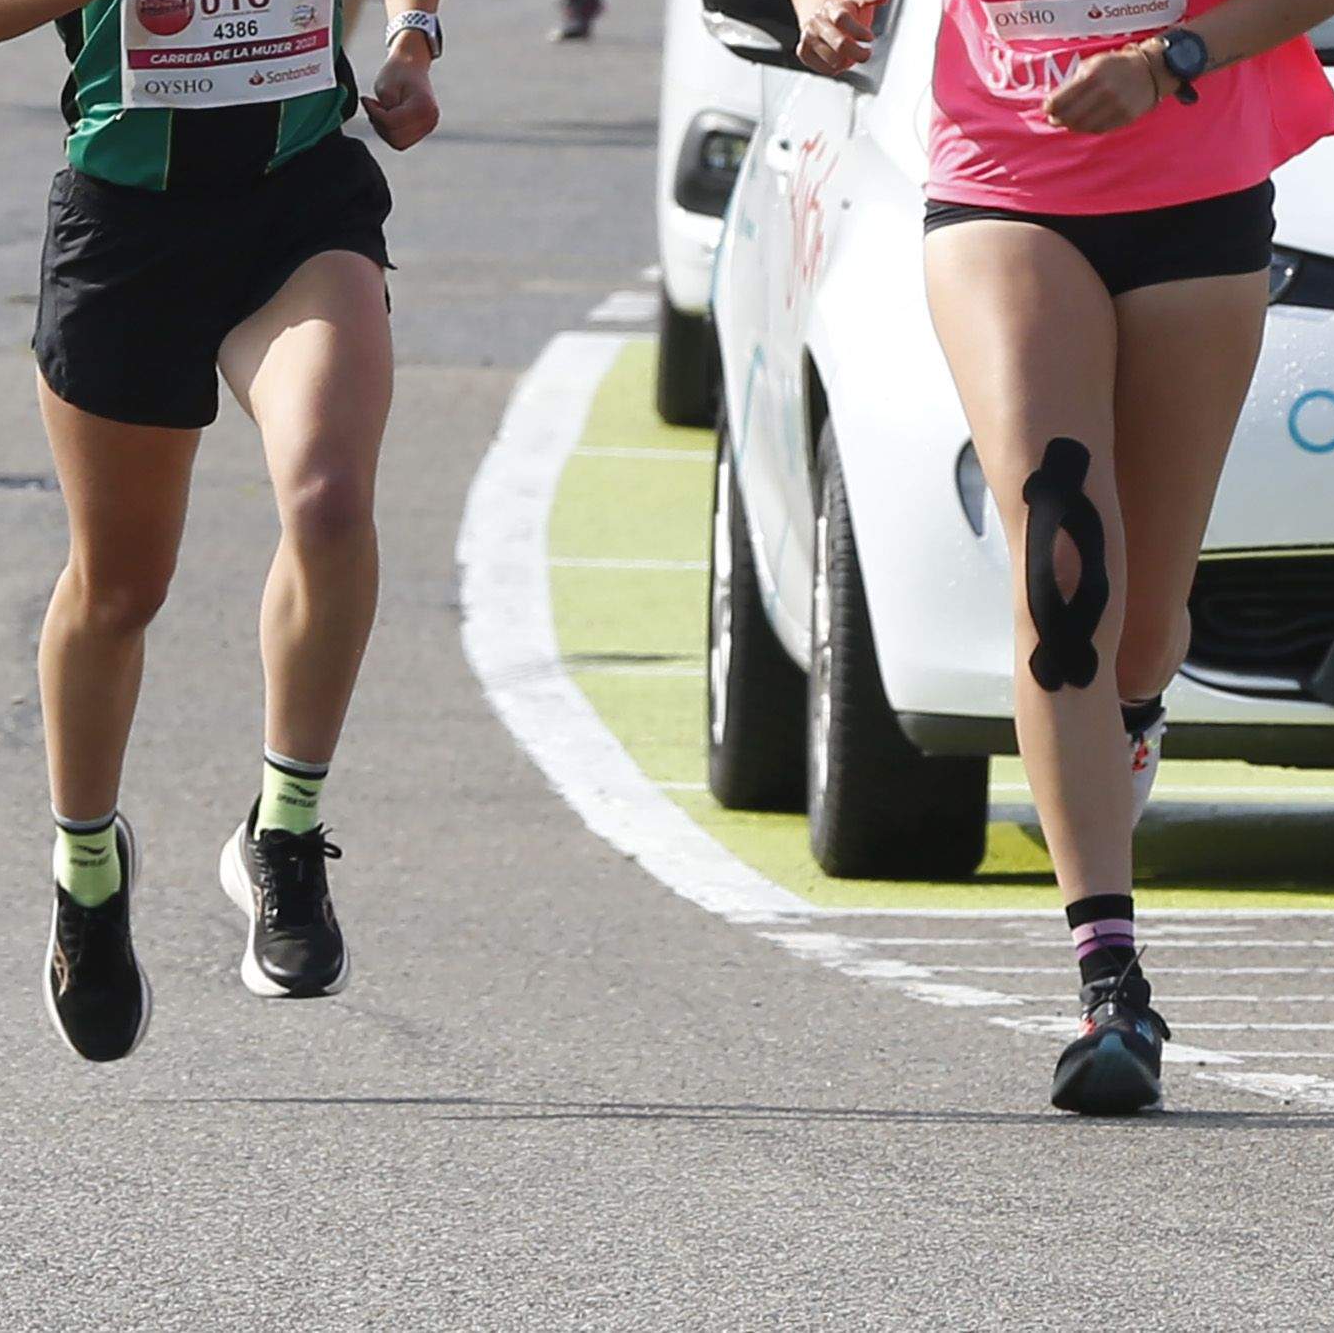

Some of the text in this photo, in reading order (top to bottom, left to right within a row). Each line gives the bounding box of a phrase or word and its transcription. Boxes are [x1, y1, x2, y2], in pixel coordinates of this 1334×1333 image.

[995, 9, 1055, 27] OYSHO
[1104, 0, 1170, 18] Santander
[213, 20, 259, 40] 4386
[150, 52, 210, 65] CARRERA
[213, 49, 231, 61] DE
[233, 47, 248, 58] LA
[251, 42, 292, 56] MUJER
[266, 62, 321, 84] Santander
[987, 48, 1082, 94] SUM
[145, 78, 213, 95] OYSHO
